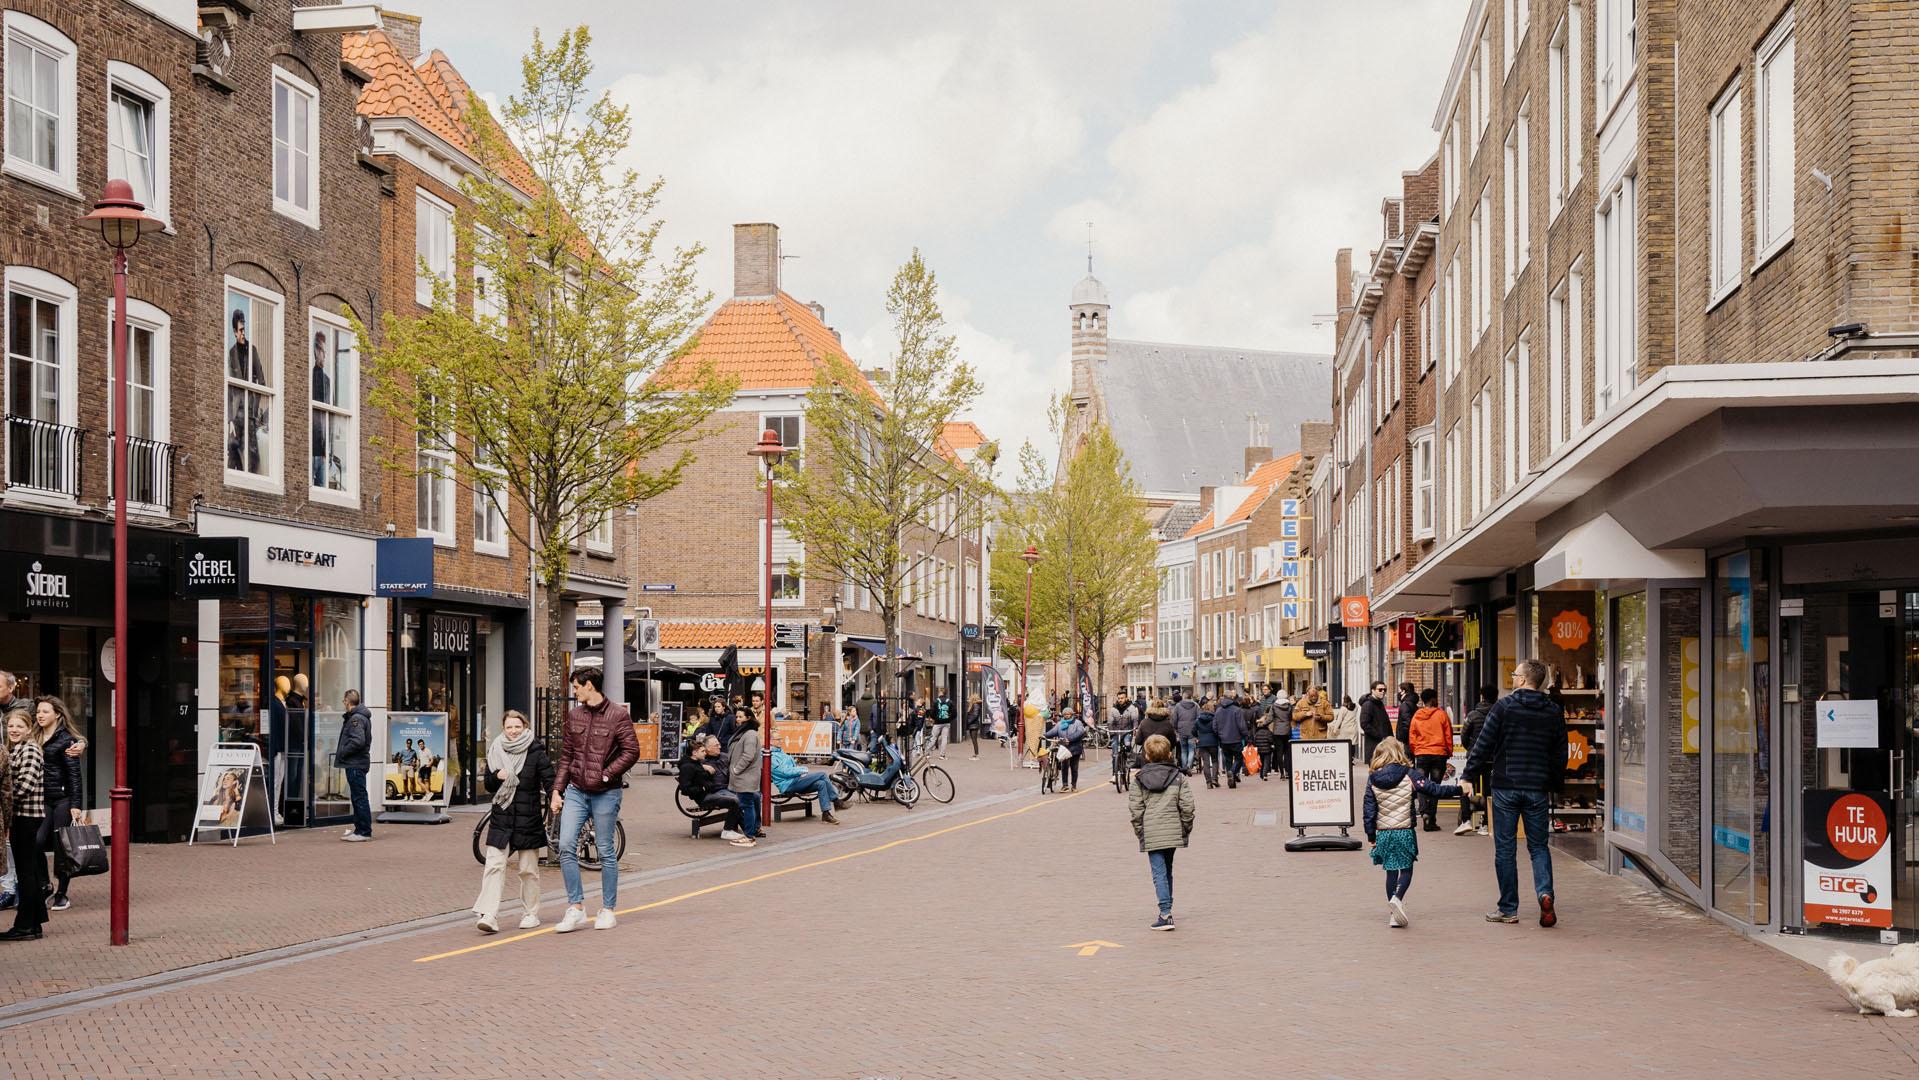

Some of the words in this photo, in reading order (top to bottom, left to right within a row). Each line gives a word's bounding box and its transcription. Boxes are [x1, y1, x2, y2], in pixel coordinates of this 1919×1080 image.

[267, 546, 303, 563] STATE
[304, 551, 314, 560] OF
[314, 554, 337, 568] ART
[1282, 500, 1298, 618] ZEEMAN
[189, 559, 236, 577] SIEBEL
[26, 572, 70, 598] SIEBEL
[433, 616, 470, 633] STUDIO
[1557, 621, 1583, 639] 30%
[433, 632, 470, 652] BLIQUE
[1420, 650, 1446, 659] kippis
[180, 704, 189, 716] 57
[1302, 746, 1336, 754] MOVES
[1294, 770, 1300, 781] 2
[1303, 769, 1337, 781] HALEN
[1295, 782, 1300, 792] 1
[1303, 780, 1347, 792] BETALEN
[1846, 806, 1865, 824] TE
[1835, 825, 1878, 844] HUUR
[1820, 876, 1868, 893] arca
